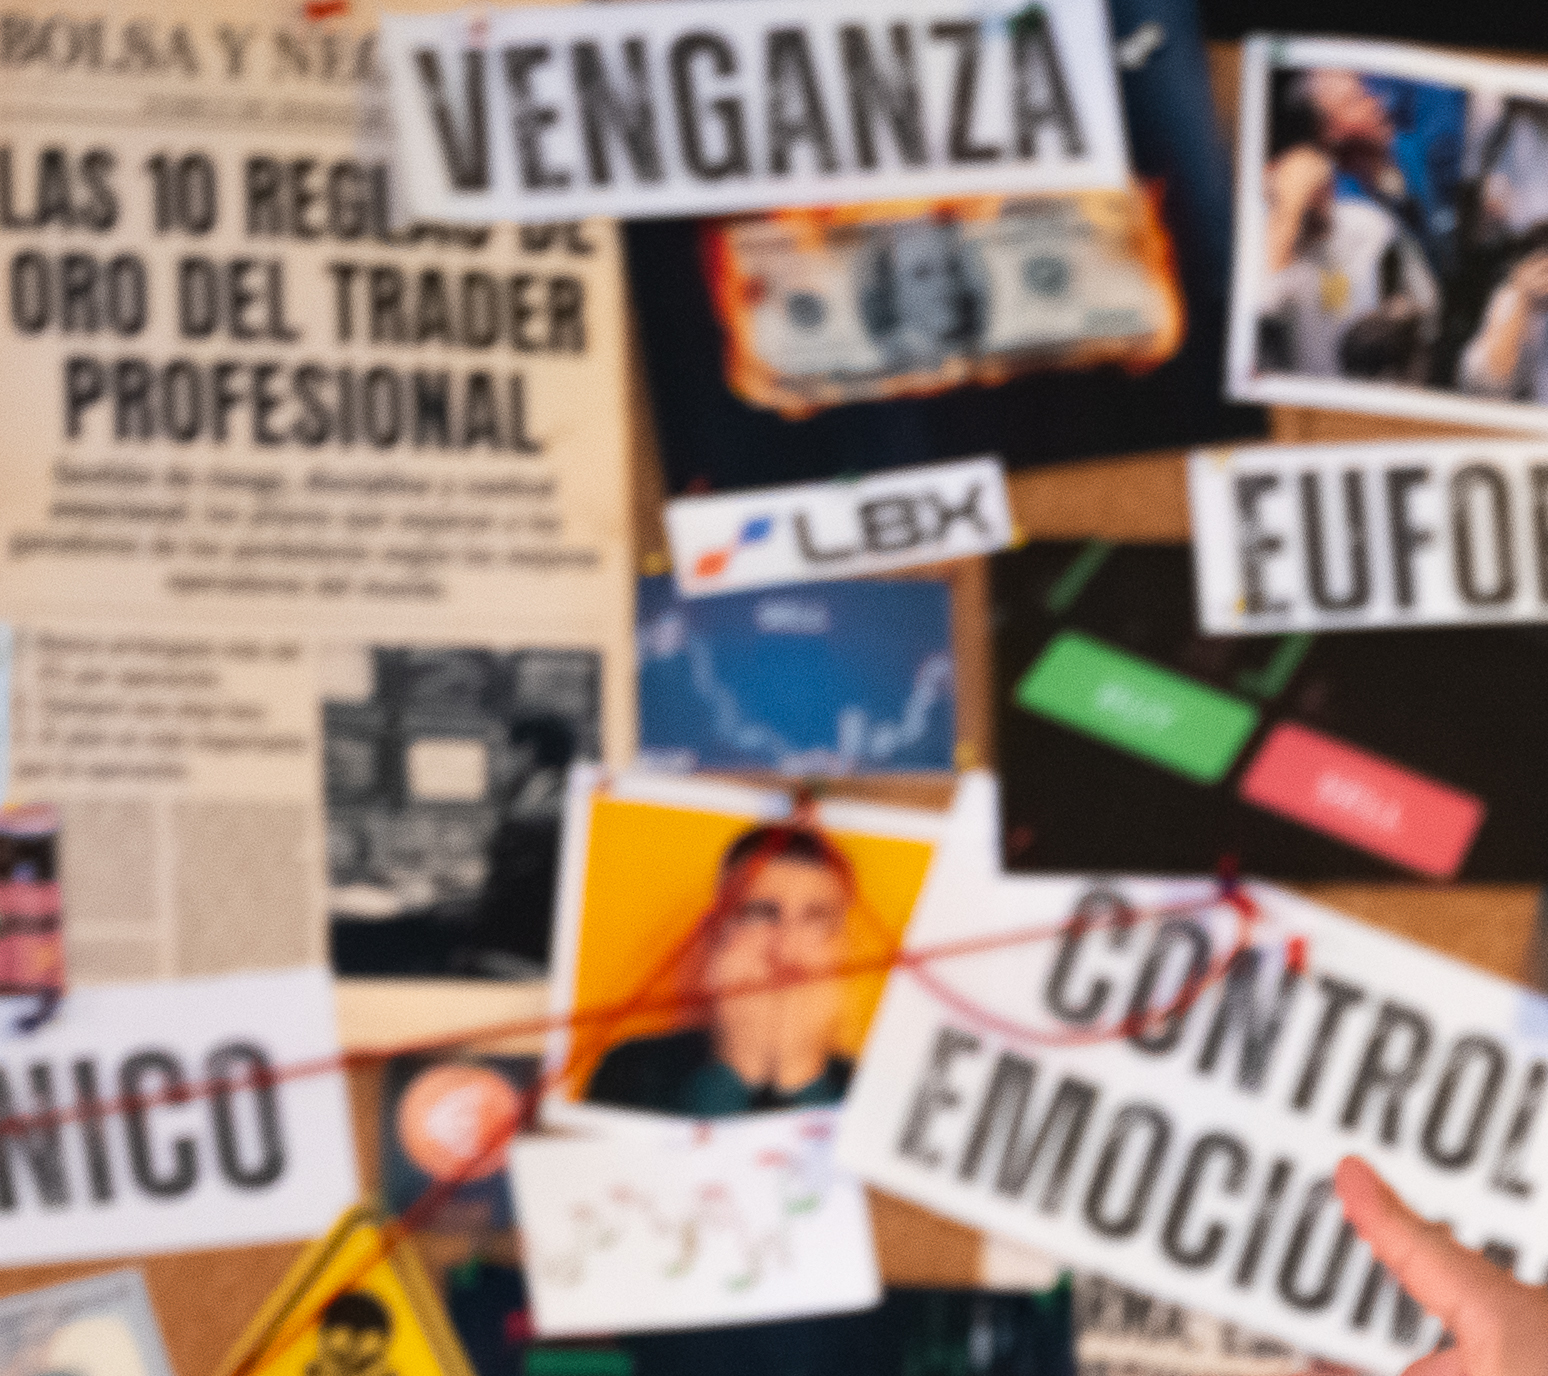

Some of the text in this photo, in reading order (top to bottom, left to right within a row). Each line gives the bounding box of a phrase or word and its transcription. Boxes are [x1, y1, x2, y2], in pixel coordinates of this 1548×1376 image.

[2, 15, 199, 75] BOLSA
[218, 25, 253, 77] Y
[413, 10, 1090, 193] VENGANZA
[0, 145, 119, 232] LAS
[146, 152, 219, 235] 10
[8, 252, 588, 355] ORO DEL TRADER
[63, 357, 543, 455] PROFESIONAL
[793, 480, 993, 565] LBX
[0, 1042, 289, 1208] NICO
